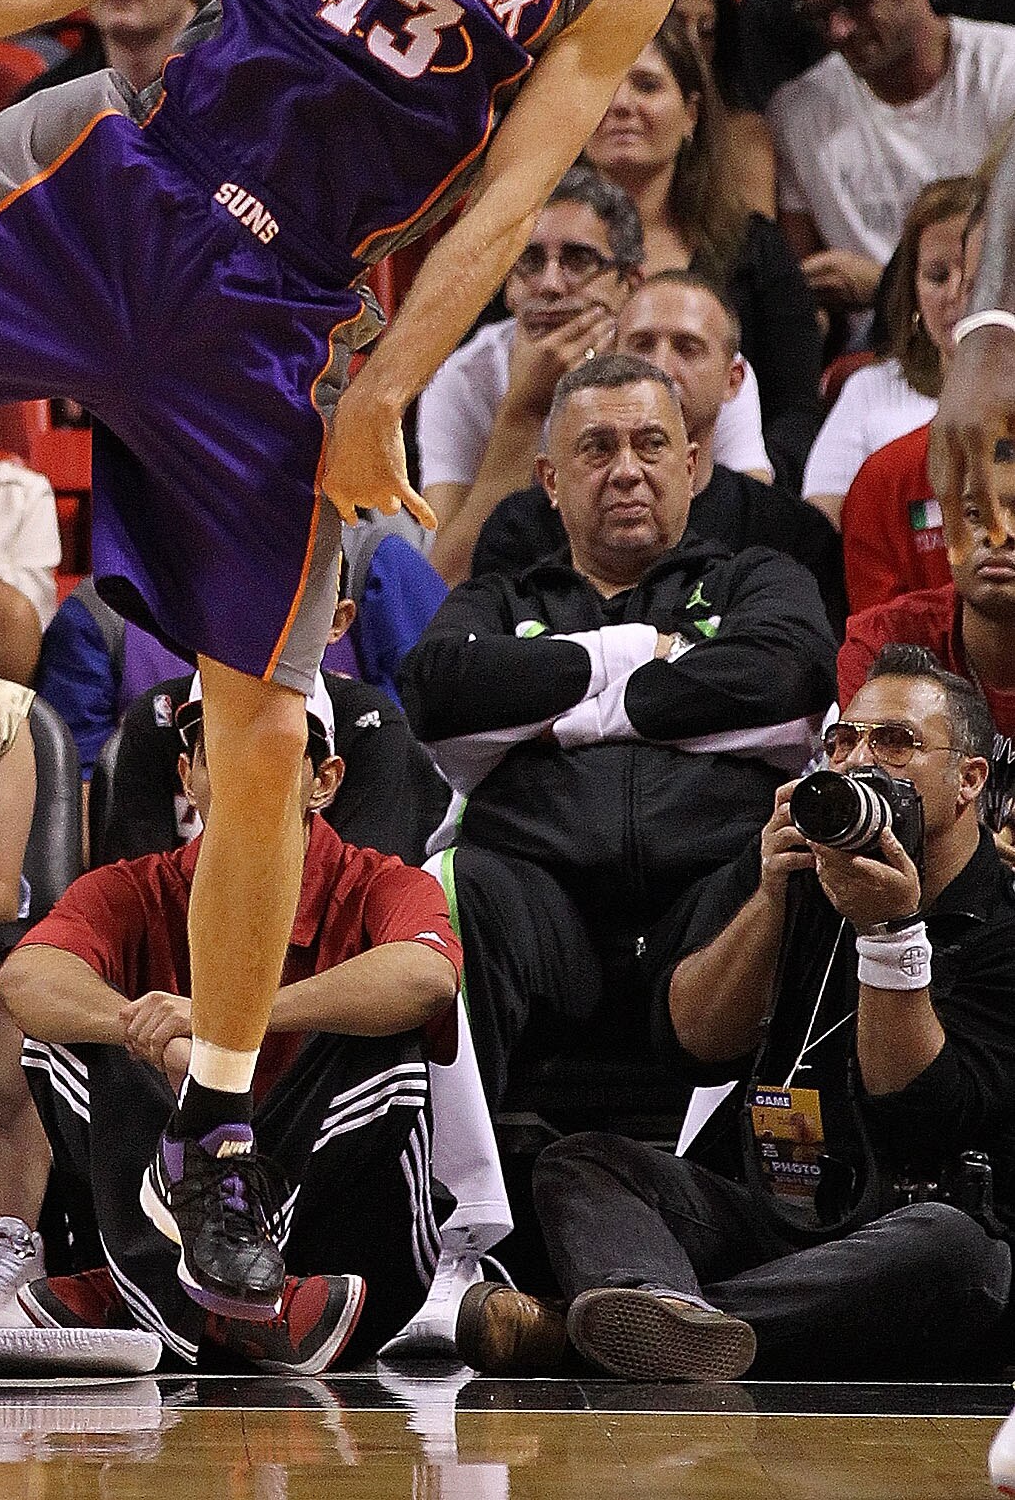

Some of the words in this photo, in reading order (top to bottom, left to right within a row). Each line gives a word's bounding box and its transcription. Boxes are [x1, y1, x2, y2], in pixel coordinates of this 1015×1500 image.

[213, 182, 280, 244] SUNS
[755, 1095, 790, 1107] GAME
[772, 1161, 821, 1175] PHOTO
